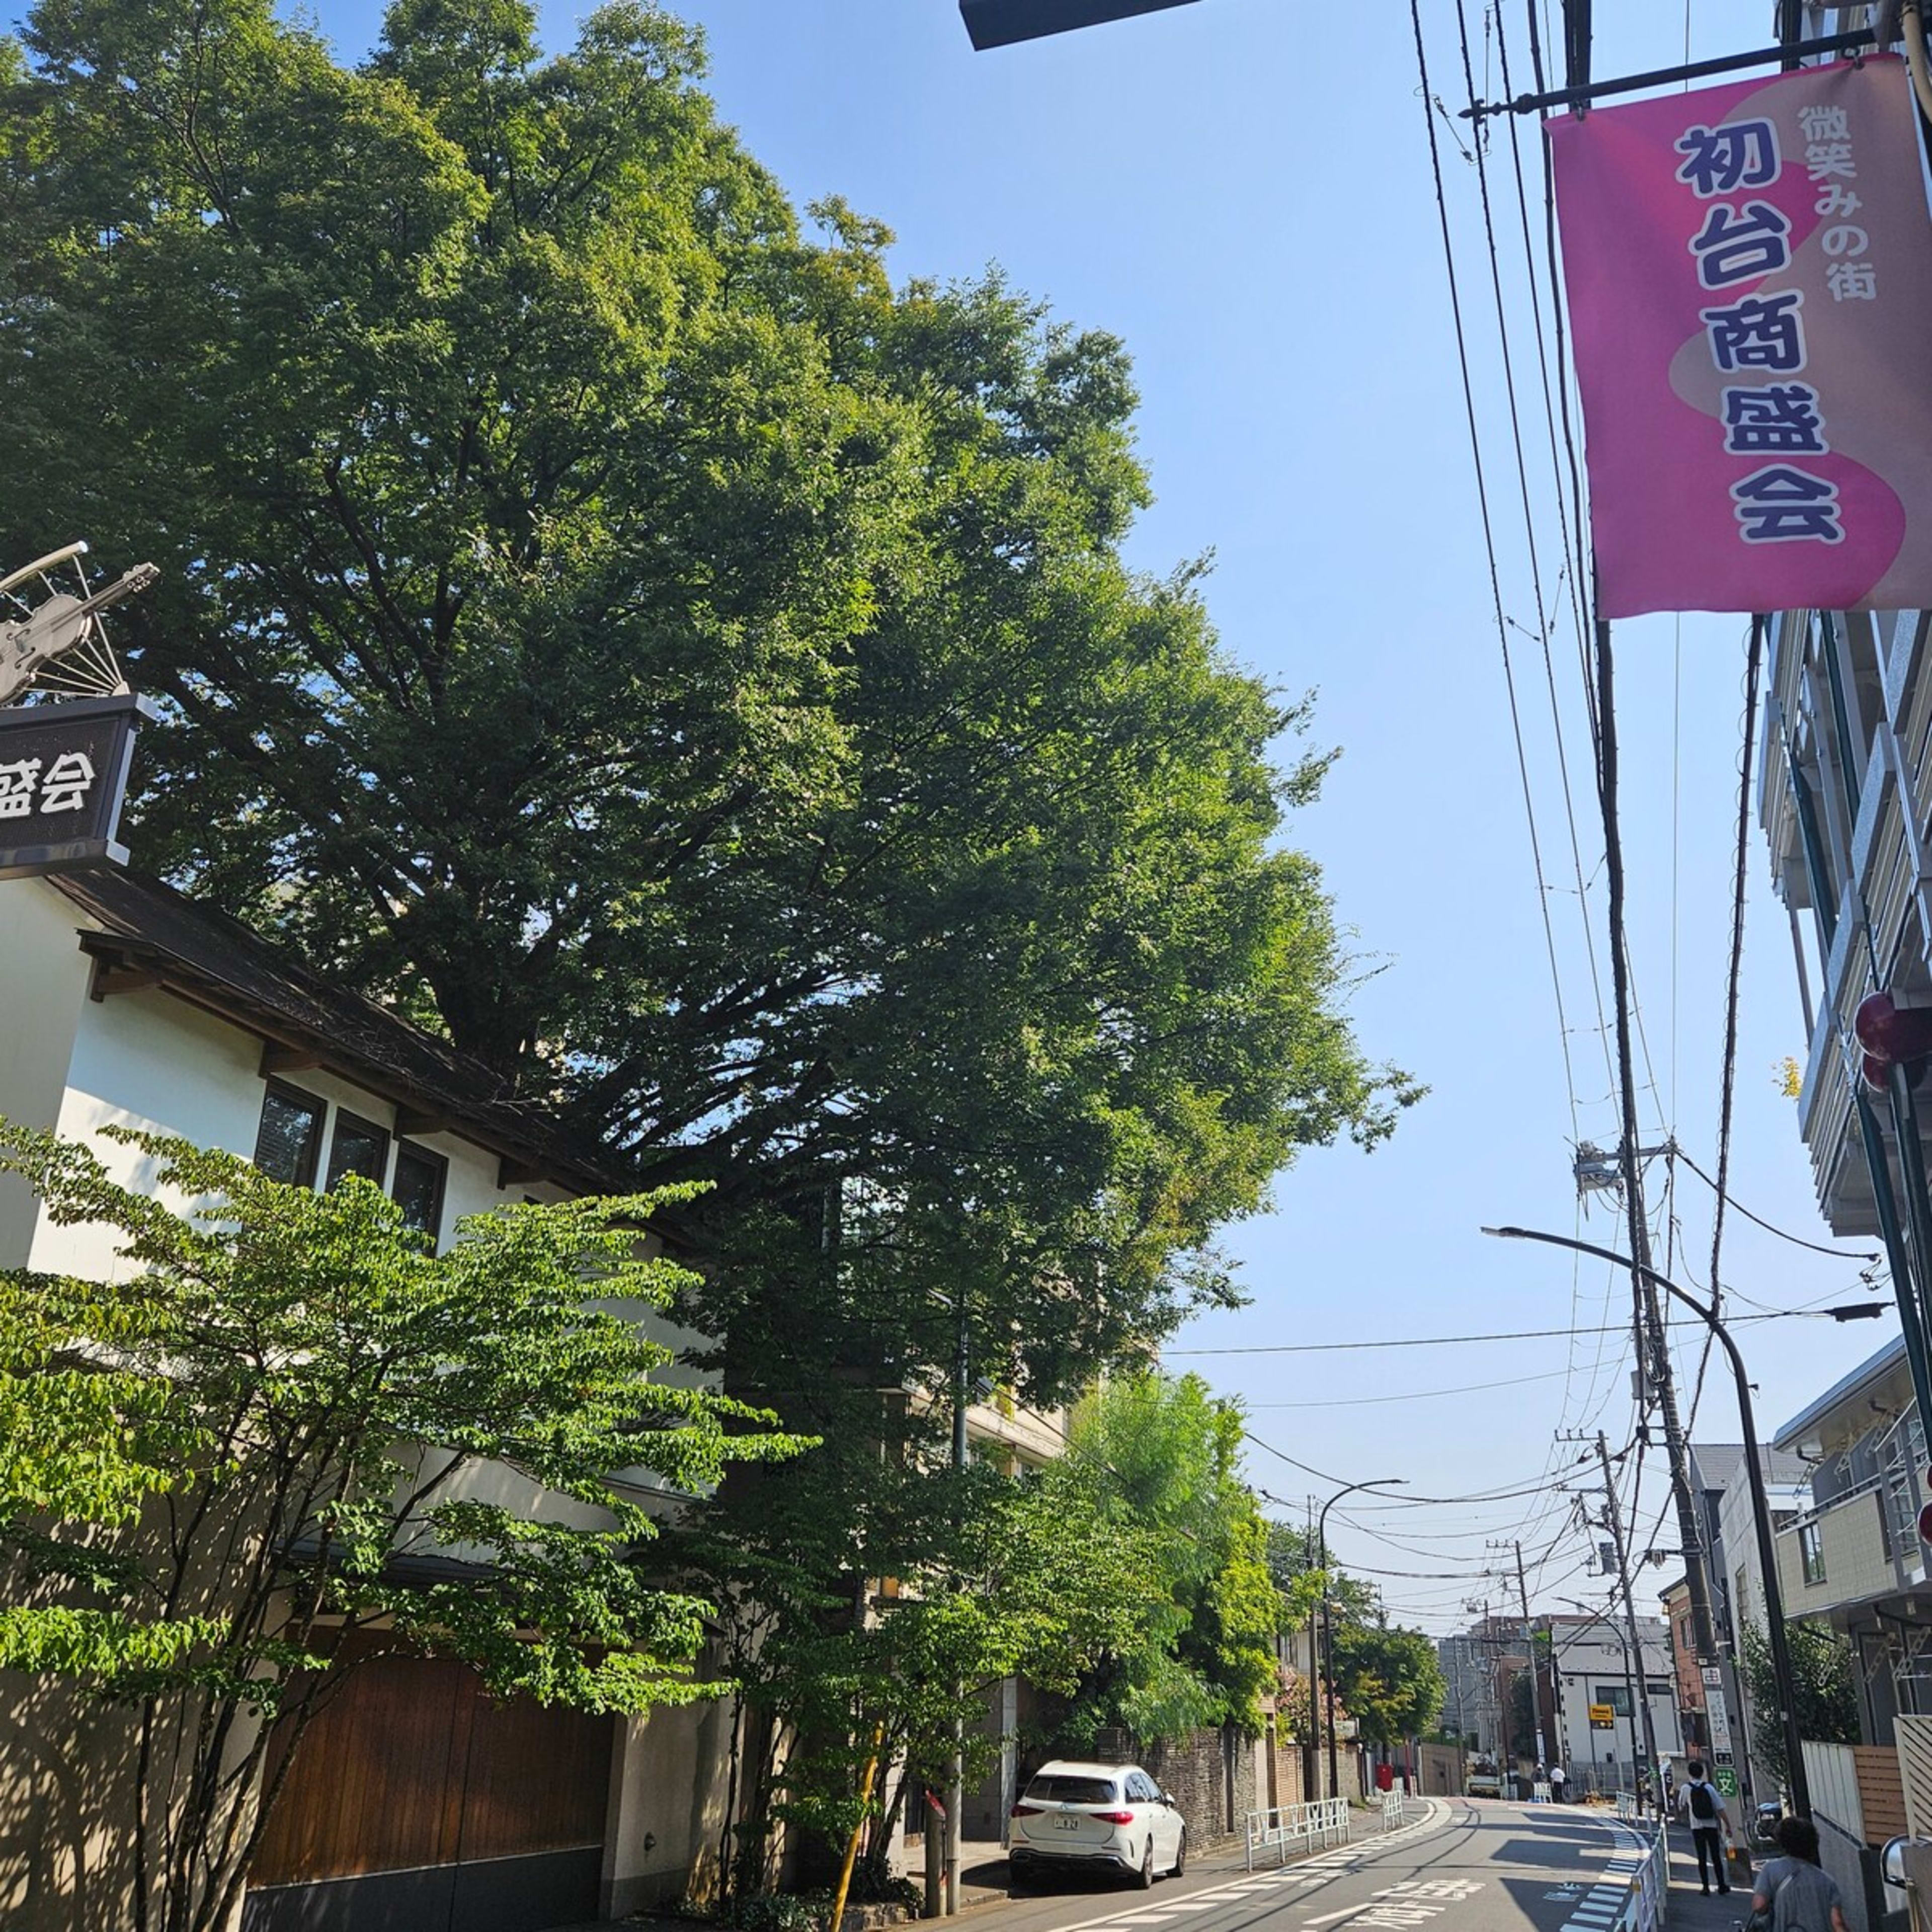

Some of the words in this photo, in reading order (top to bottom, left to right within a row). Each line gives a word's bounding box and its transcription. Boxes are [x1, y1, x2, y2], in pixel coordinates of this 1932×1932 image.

[1676, 118, 1843, 544] 初台商盛会
[1797, 105, 1877, 302] 微笑みの街
